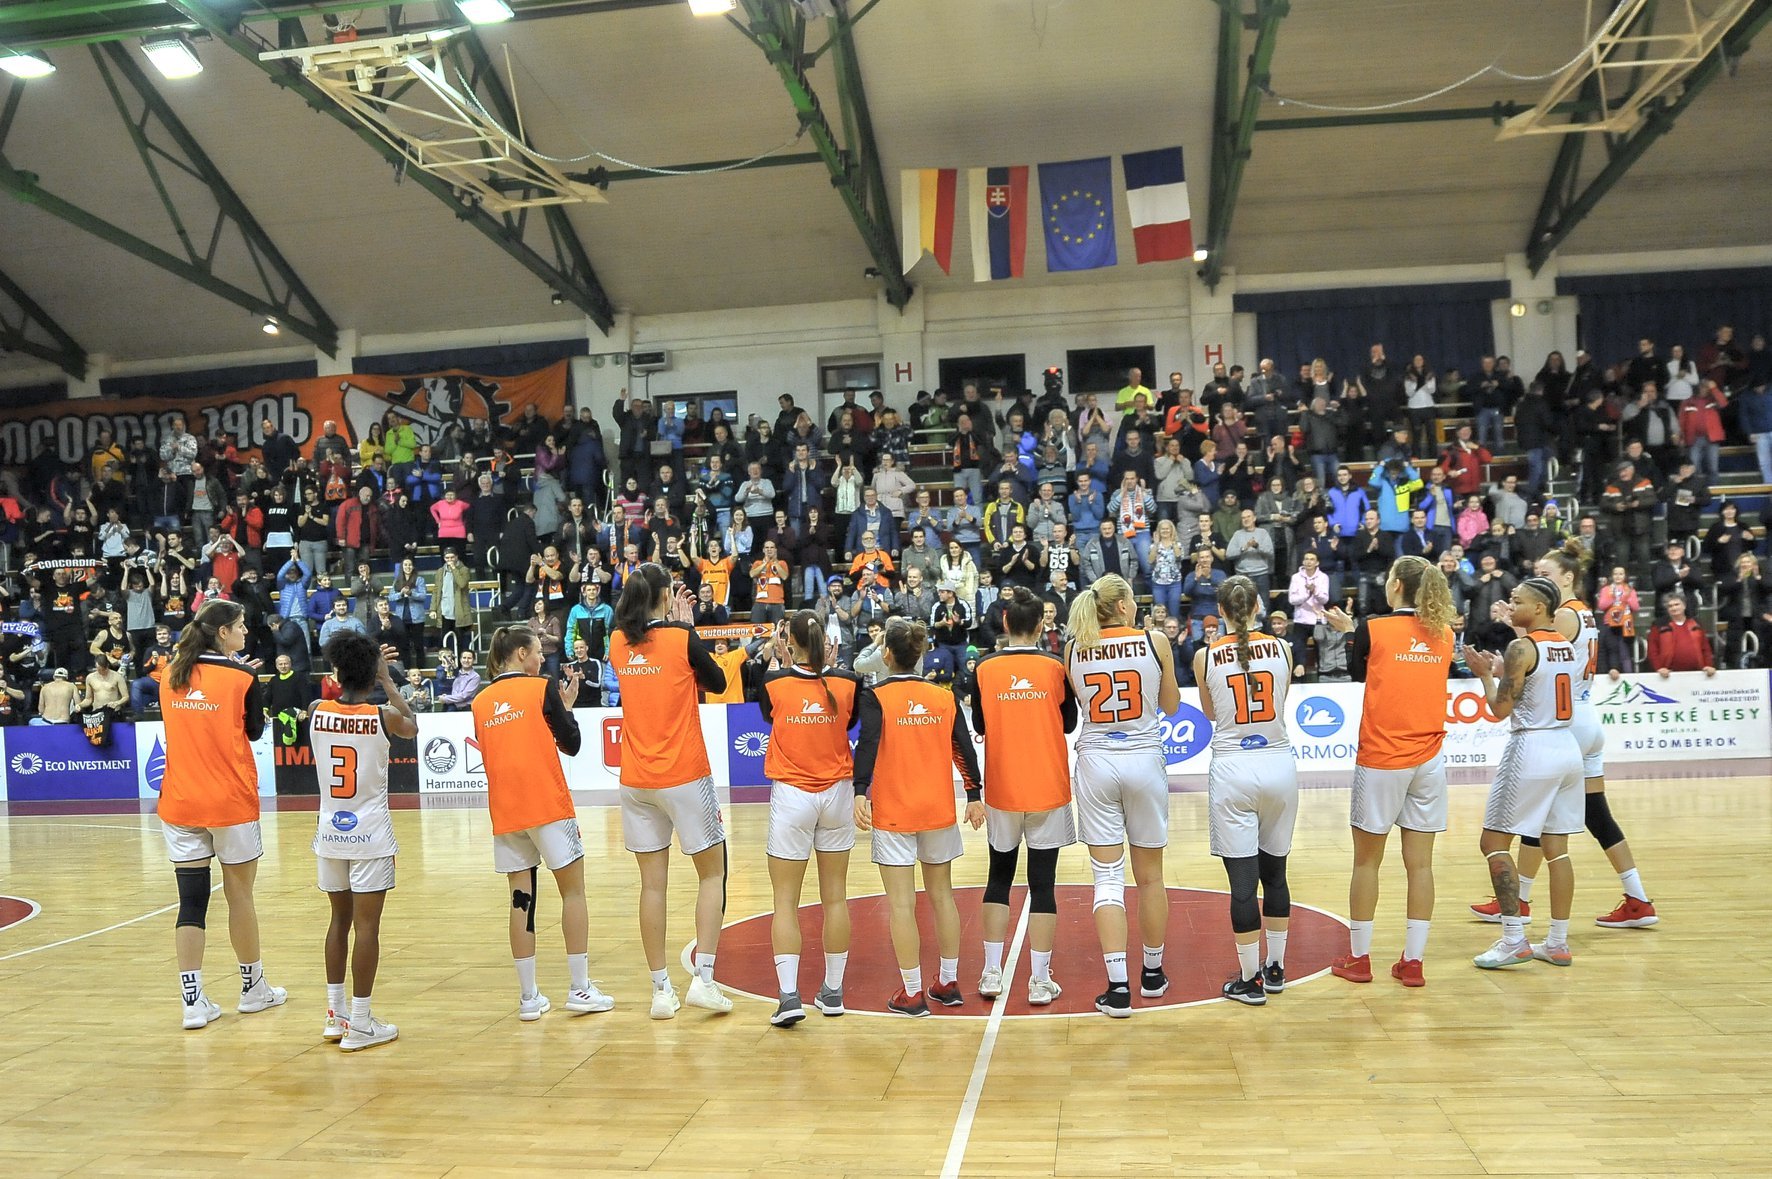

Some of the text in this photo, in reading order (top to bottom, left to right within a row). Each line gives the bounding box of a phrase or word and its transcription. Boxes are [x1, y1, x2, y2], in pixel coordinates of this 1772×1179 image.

[895, 362, 912, 382] H
[201, 396, 310, 449] 1906
[38, 558, 96, 570] CONCORDIA
[703, 627, 750, 637] RUŽOMBEROK
[1076, 641, 1147, 663] YATSKOVETS
[1212, 641, 1281, 667] MIŠNOVÁ
[1395, 653, 1443, 664] HARMONY
[618, 665, 662, 676] HARMONY
[997, 690, 1049, 702] HARMONY
[1083, 669, 1142, 723] 23
[1226, 670, 1277, 725] 13
[1555, 672, 1573, 721] 0
[171, 700, 220, 712] HARMONY
[484, 709, 526, 729] HARMONY
[786, 714, 839, 725] HARMONY
[896, 715, 943, 726] HARMONY
[1602, 707, 1760, 725] MESTSKÉ LESY
[313, 714, 378, 735] ELLENBERG
[1624, 737, 1737, 749] RUŽOMBEROK
[274, 746, 317, 766] IM
[1450, 754, 1467, 763] 102
[1470, 754, 1487, 763] 103
[44, 760, 131, 771] ECO INVESTMENT
[330, 745, 358, 799] 3
[322, 833, 372, 844] HARMONY
